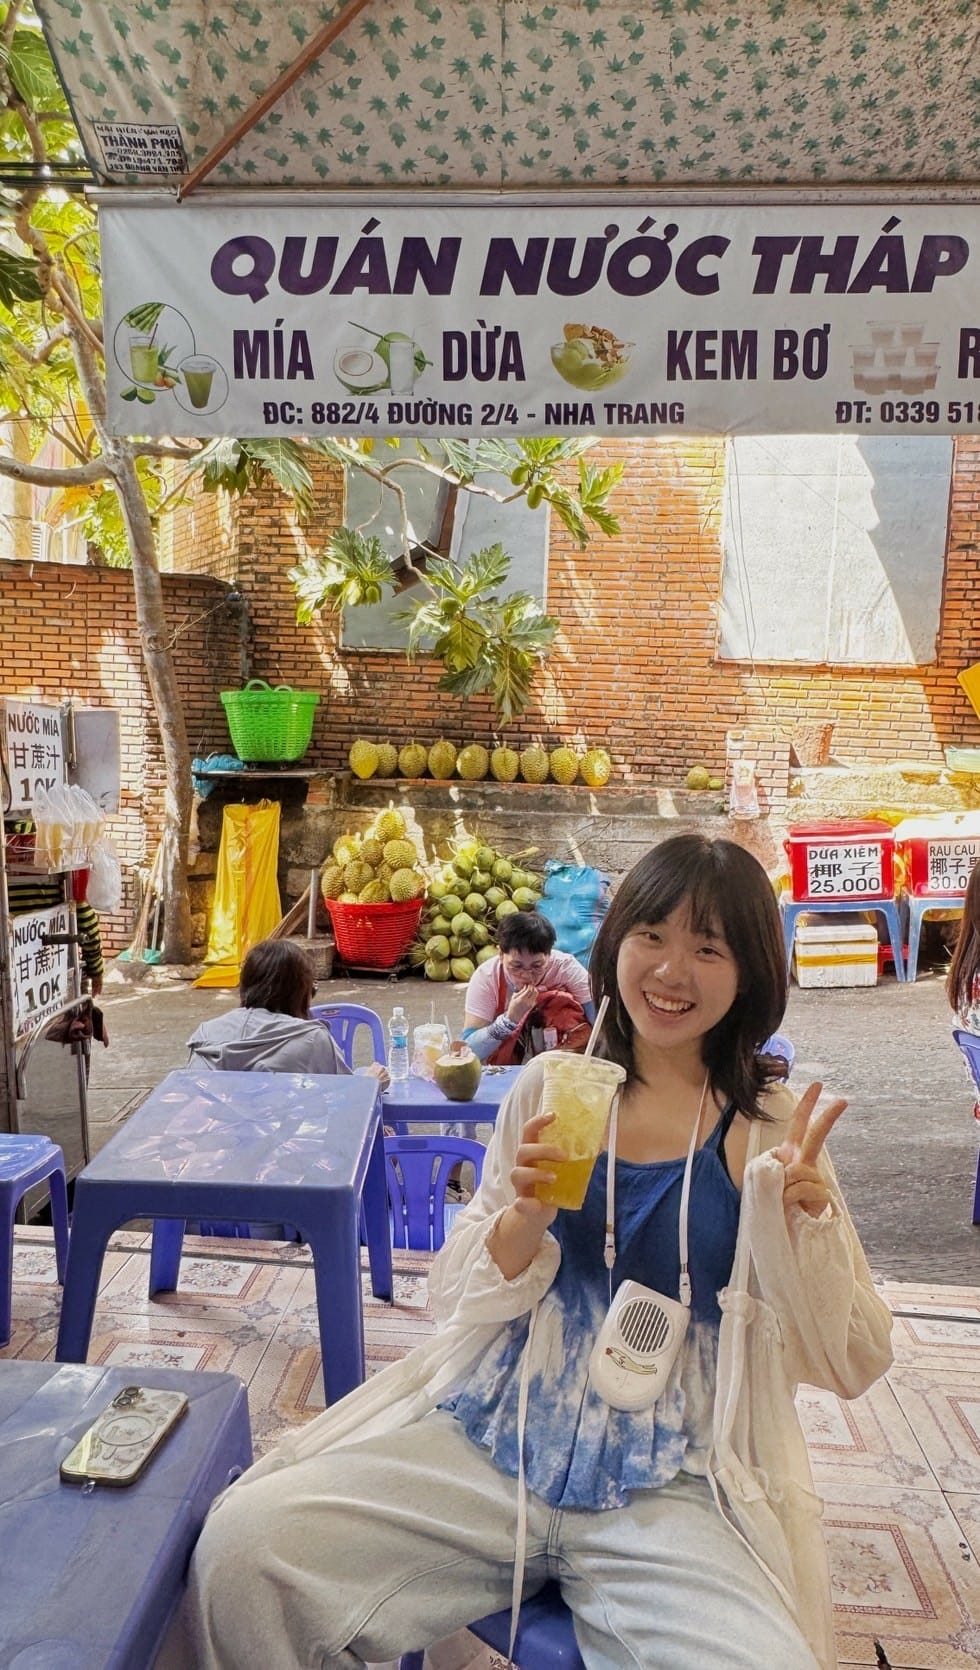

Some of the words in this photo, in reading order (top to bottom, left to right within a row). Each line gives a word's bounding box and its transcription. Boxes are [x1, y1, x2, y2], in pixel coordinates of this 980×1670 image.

[210, 217, 462, 304] QUÁN
[479, 216, 731, 297] NƯỚC
[752, 215, 970, 296] THÁP
[232, 318, 315, 381] MÍA
[442, 319, 526, 382] DỪA
[666, 330, 758, 382] KEM
[773, 323, 832, 381] BƠ
[263, 401, 303, 425] ĐC:
[311, 402, 379, 425] 882/4
[387, 397, 473, 426] ĐƯỜNG
[480, 403, 519, 426] 2/4
[545, 403, 596, 426] NHA
[603, 402, 685, 425] TRANG
[835, 401, 872, 424] ĐT:
[880, 401, 940, 424] 0339
[8, 711, 40, 734] NƯỚC
[42, 715, 60, 736] MÍA
[9, 741, 60, 770] 甘蔗汁
[929, 845, 951, 856] RAU
[809, 861, 880, 878] 椰子
[930, 875, 968, 889] 30.0
[810, 877, 880, 894] 25.000
[14, 918, 46, 948] NƯỚC
[48, 911, 66, 934] MÍA
[24, 974, 62, 1013] 10K
